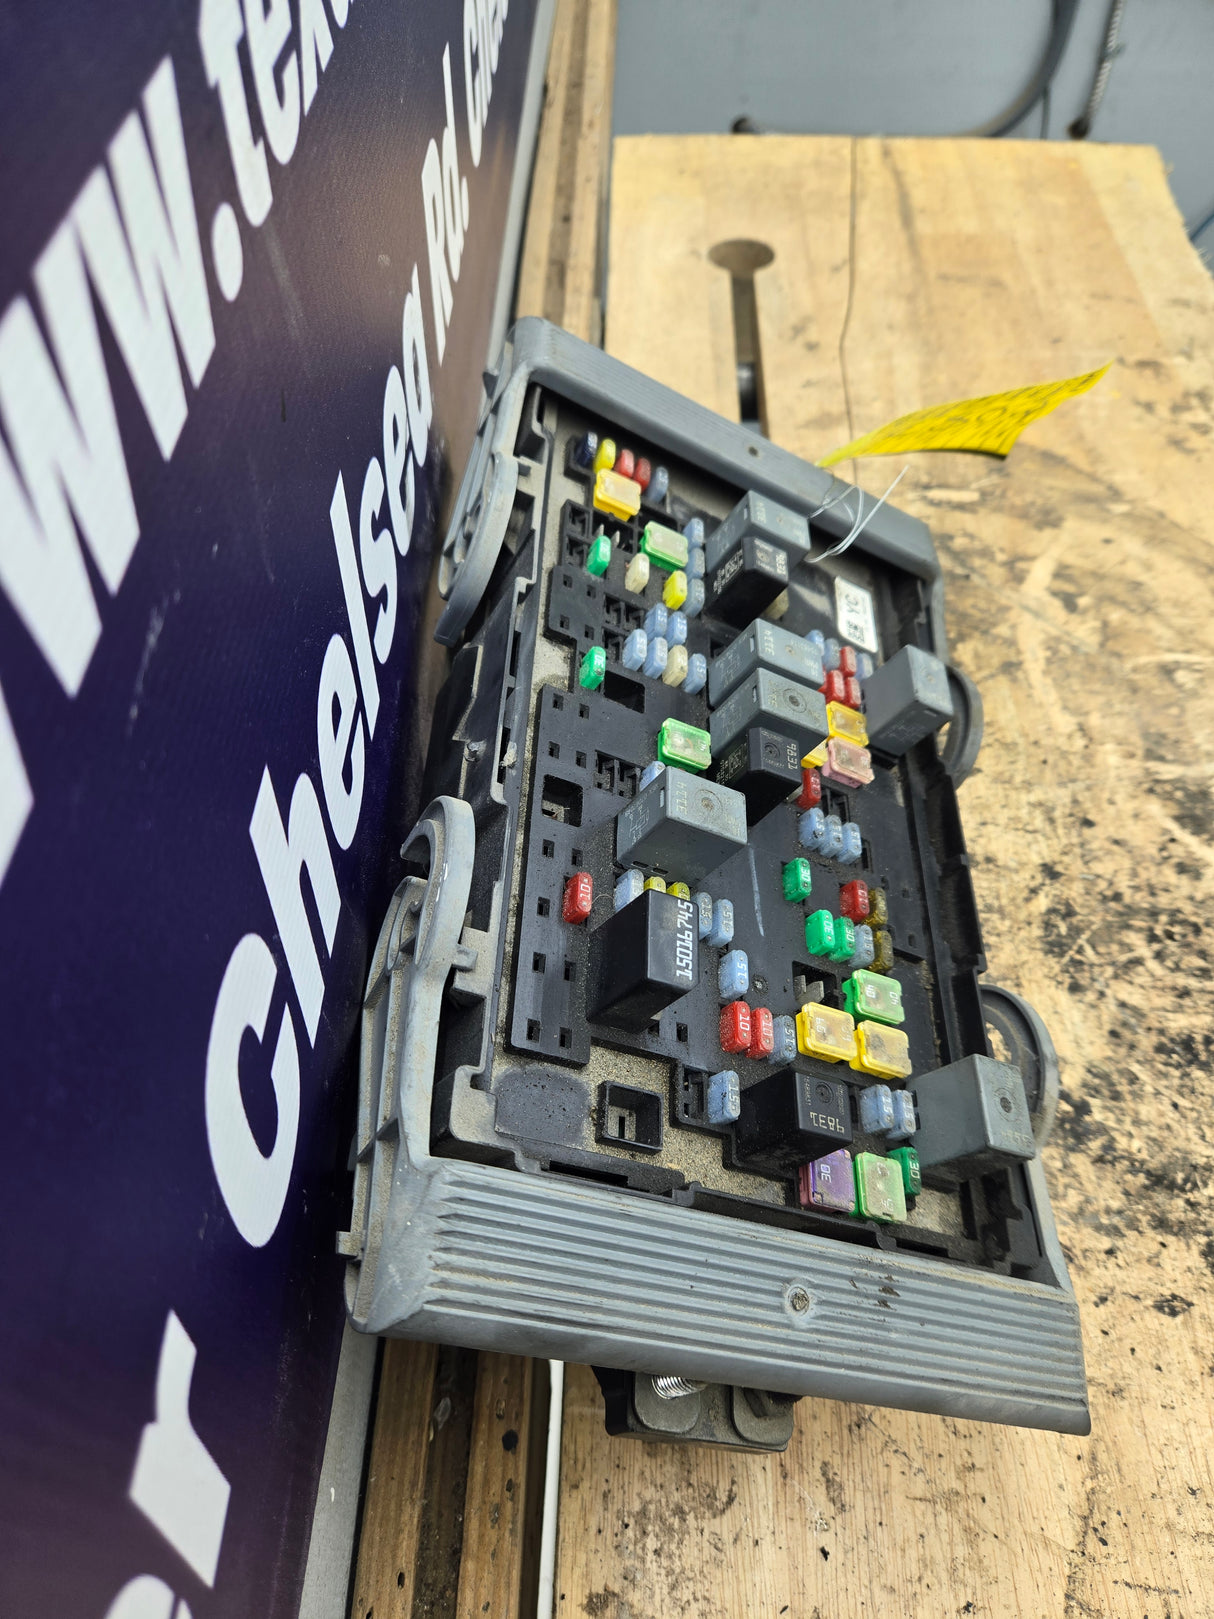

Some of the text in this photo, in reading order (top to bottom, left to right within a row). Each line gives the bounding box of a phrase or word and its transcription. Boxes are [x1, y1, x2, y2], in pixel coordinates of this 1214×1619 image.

[205, 261, 432, 1247] Chelsea
[421, 41, 469, 367] Rd.
[786, 743, 799, 770] 9831
[675, 781, 689, 815] 3114
[801, 868, 811, 881] 30
[579, 883, 592, 899] 10
[857, 889, 869, 904] 10
[823, 921, 835, 938] 30
[845, 928, 856, 943] 30
[675, 899, 694, 981] 15016745
[736, 961, 748, 978] 15
[888, 991, 900, 1006] 40
[739, 1014, 751, 1032] 10
[761, 1020, 774, 1038] 10
[784, 1028, 796, 1046] 15
[809, 1110, 846, 1135] 9831
[820, 1163, 832, 1184] 30
[910, 1161, 921, 1179] 30
